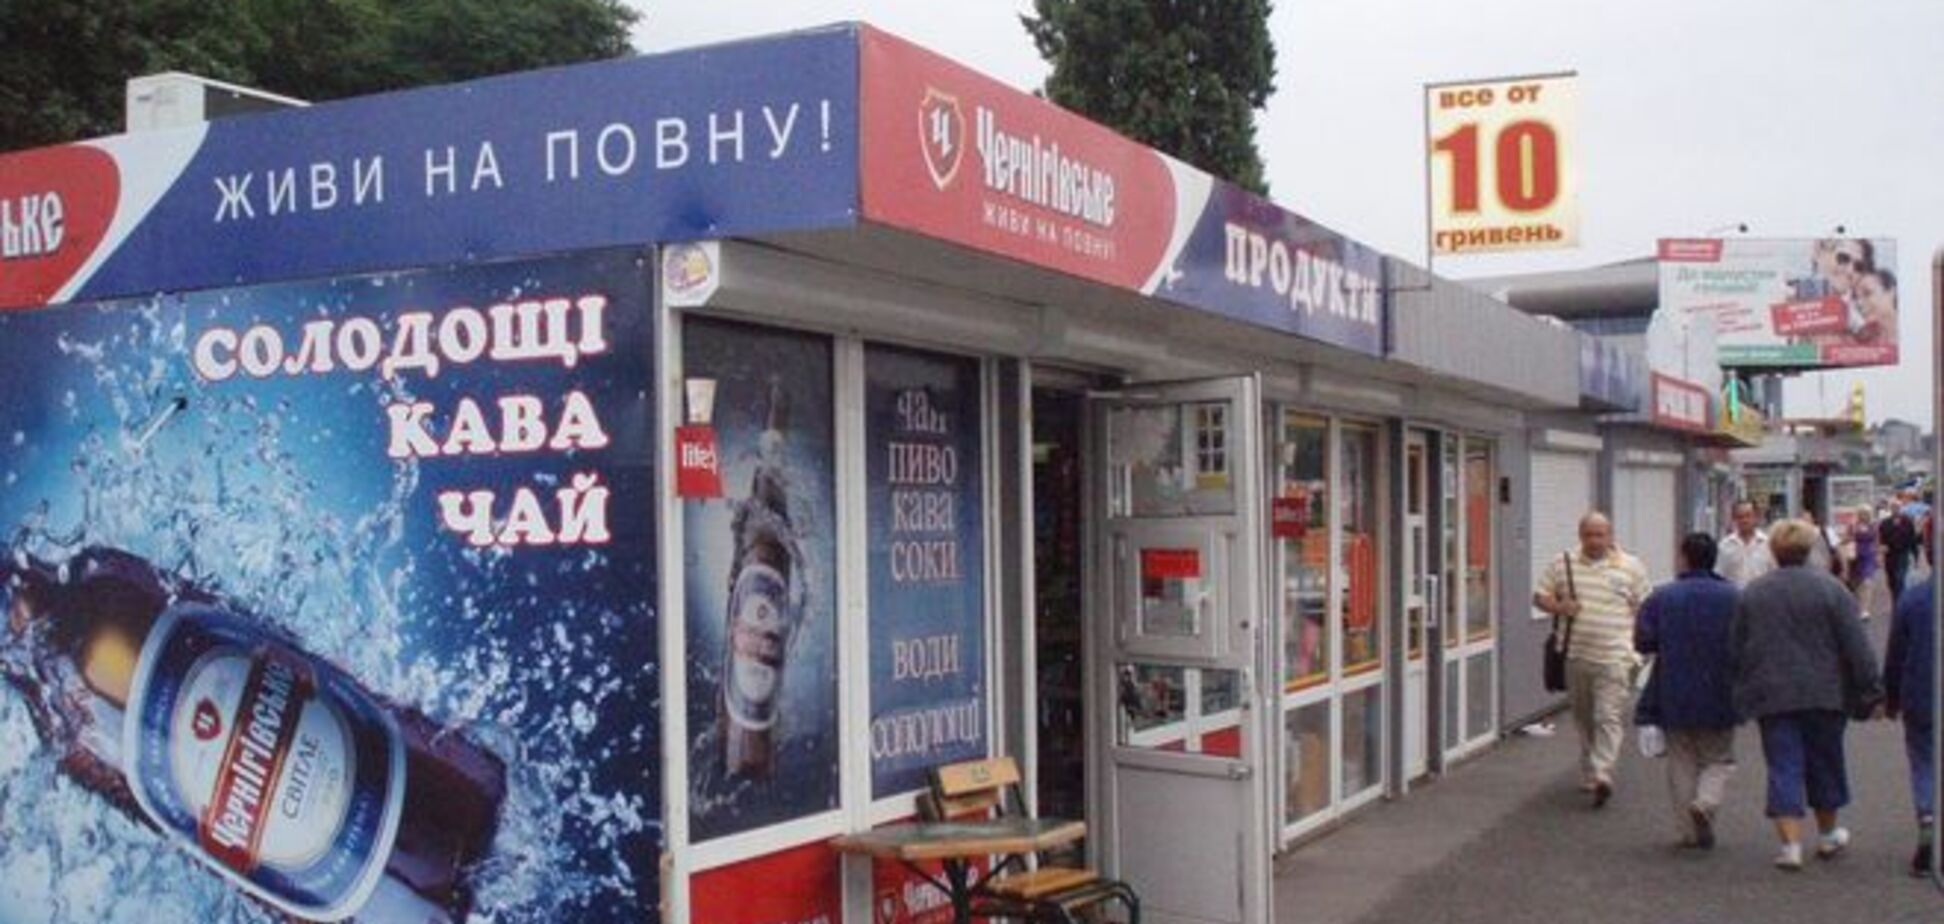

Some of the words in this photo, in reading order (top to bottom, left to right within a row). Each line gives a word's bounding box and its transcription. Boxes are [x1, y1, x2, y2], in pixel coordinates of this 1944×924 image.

[1439, 88, 1494, 109] все
[1507, 84, 1542, 103] от
[213, 155, 384, 222] ЖИВИ
[424, 141, 503, 196] НА
[546, 99, 831, 182] ПОВНУ!
[977, 105, 1115, 227] Чернігівське
[1432, 119, 1558, 213] 10
[983, 199, 1030, 236] ЖИВИ
[1036, 218, 1058, 243] НА
[1436, 223, 1562, 252] гривень
[1225, 222, 1378, 325] ПРОДУКТИ
[194, 295, 608, 382] СОЛОДОЩІ
[386, 389, 609, 458] КАВА
[437, 472, 611, 548] ЧАЙ
